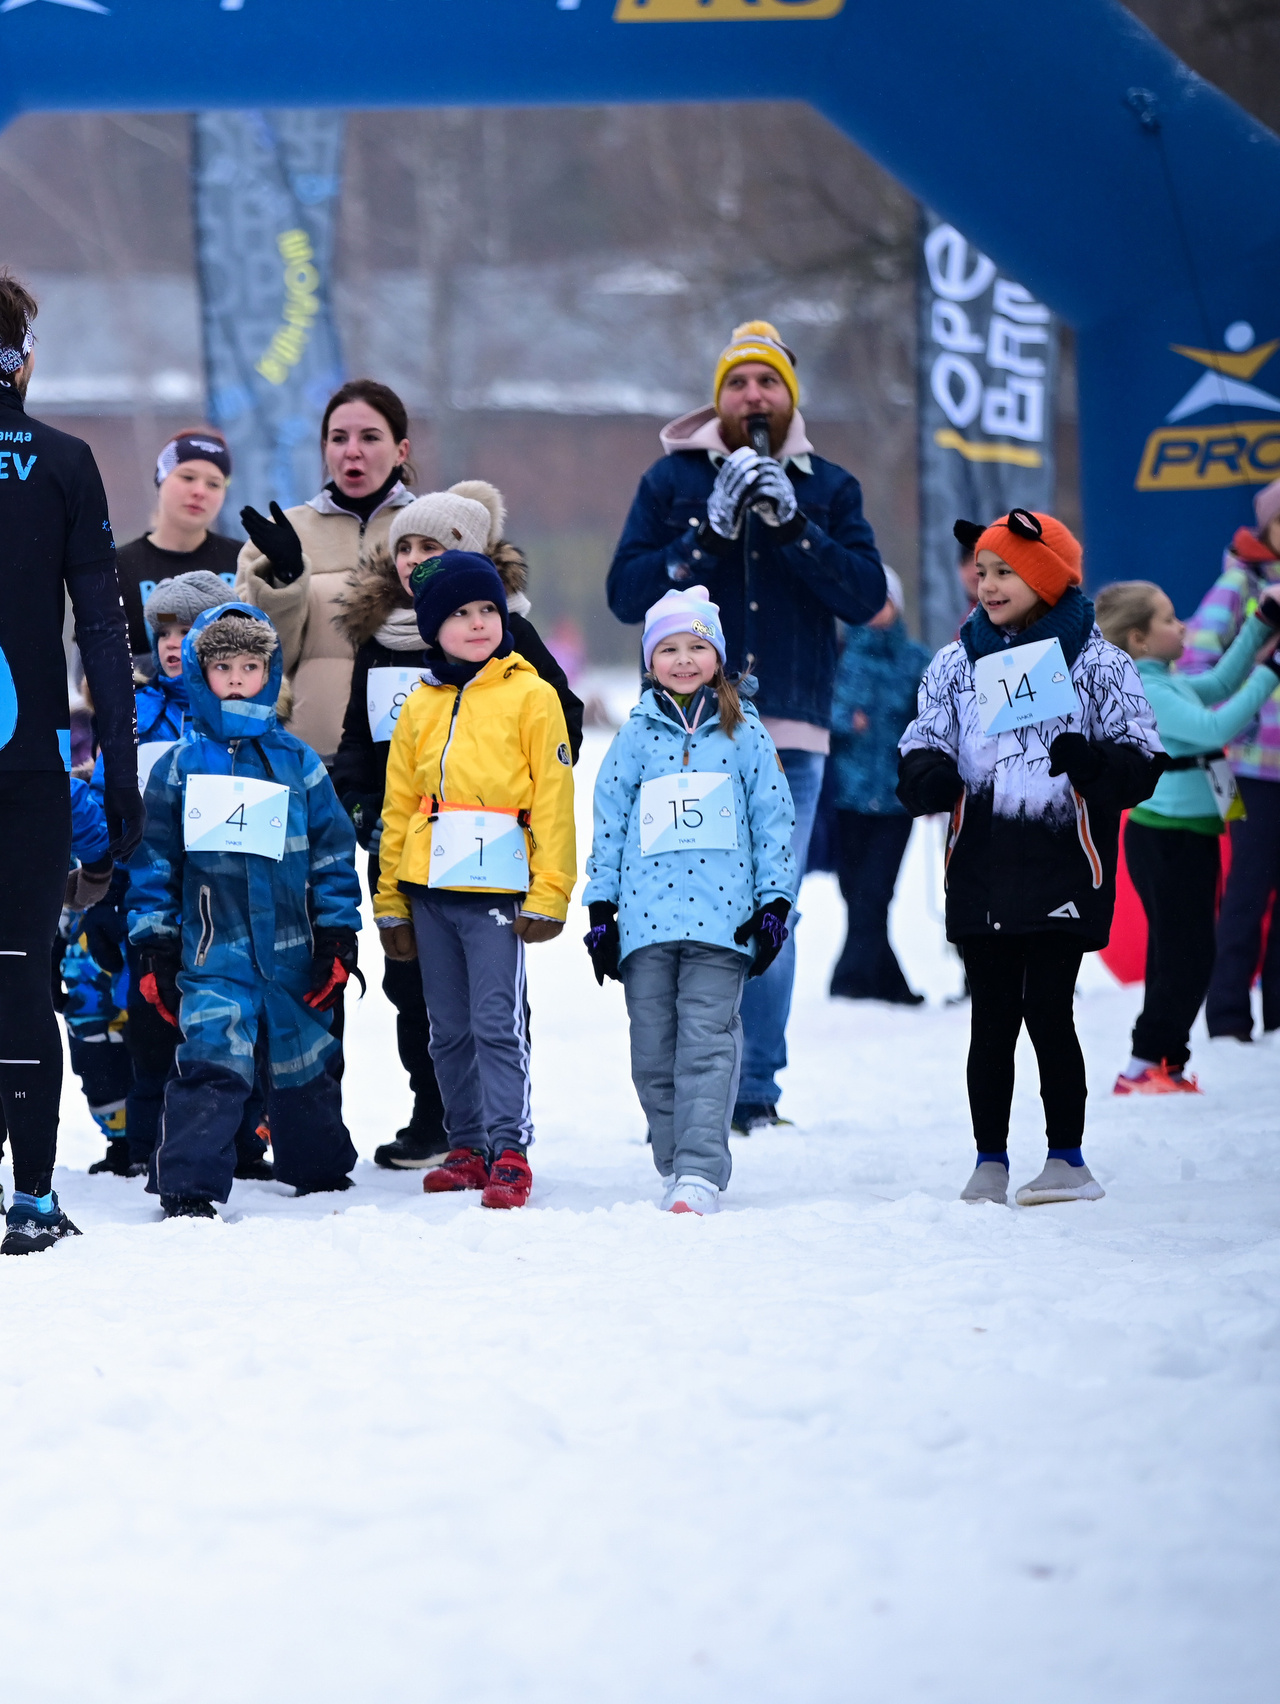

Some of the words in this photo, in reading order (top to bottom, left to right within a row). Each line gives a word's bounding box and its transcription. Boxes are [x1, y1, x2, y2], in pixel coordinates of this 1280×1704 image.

[998, 672, 1037, 708] 14
[225, 802, 248, 832] 4
[668, 798, 704, 830] 15
[474, 837, 483, 867] 1
[14, 1091, 26, 1099] H1
